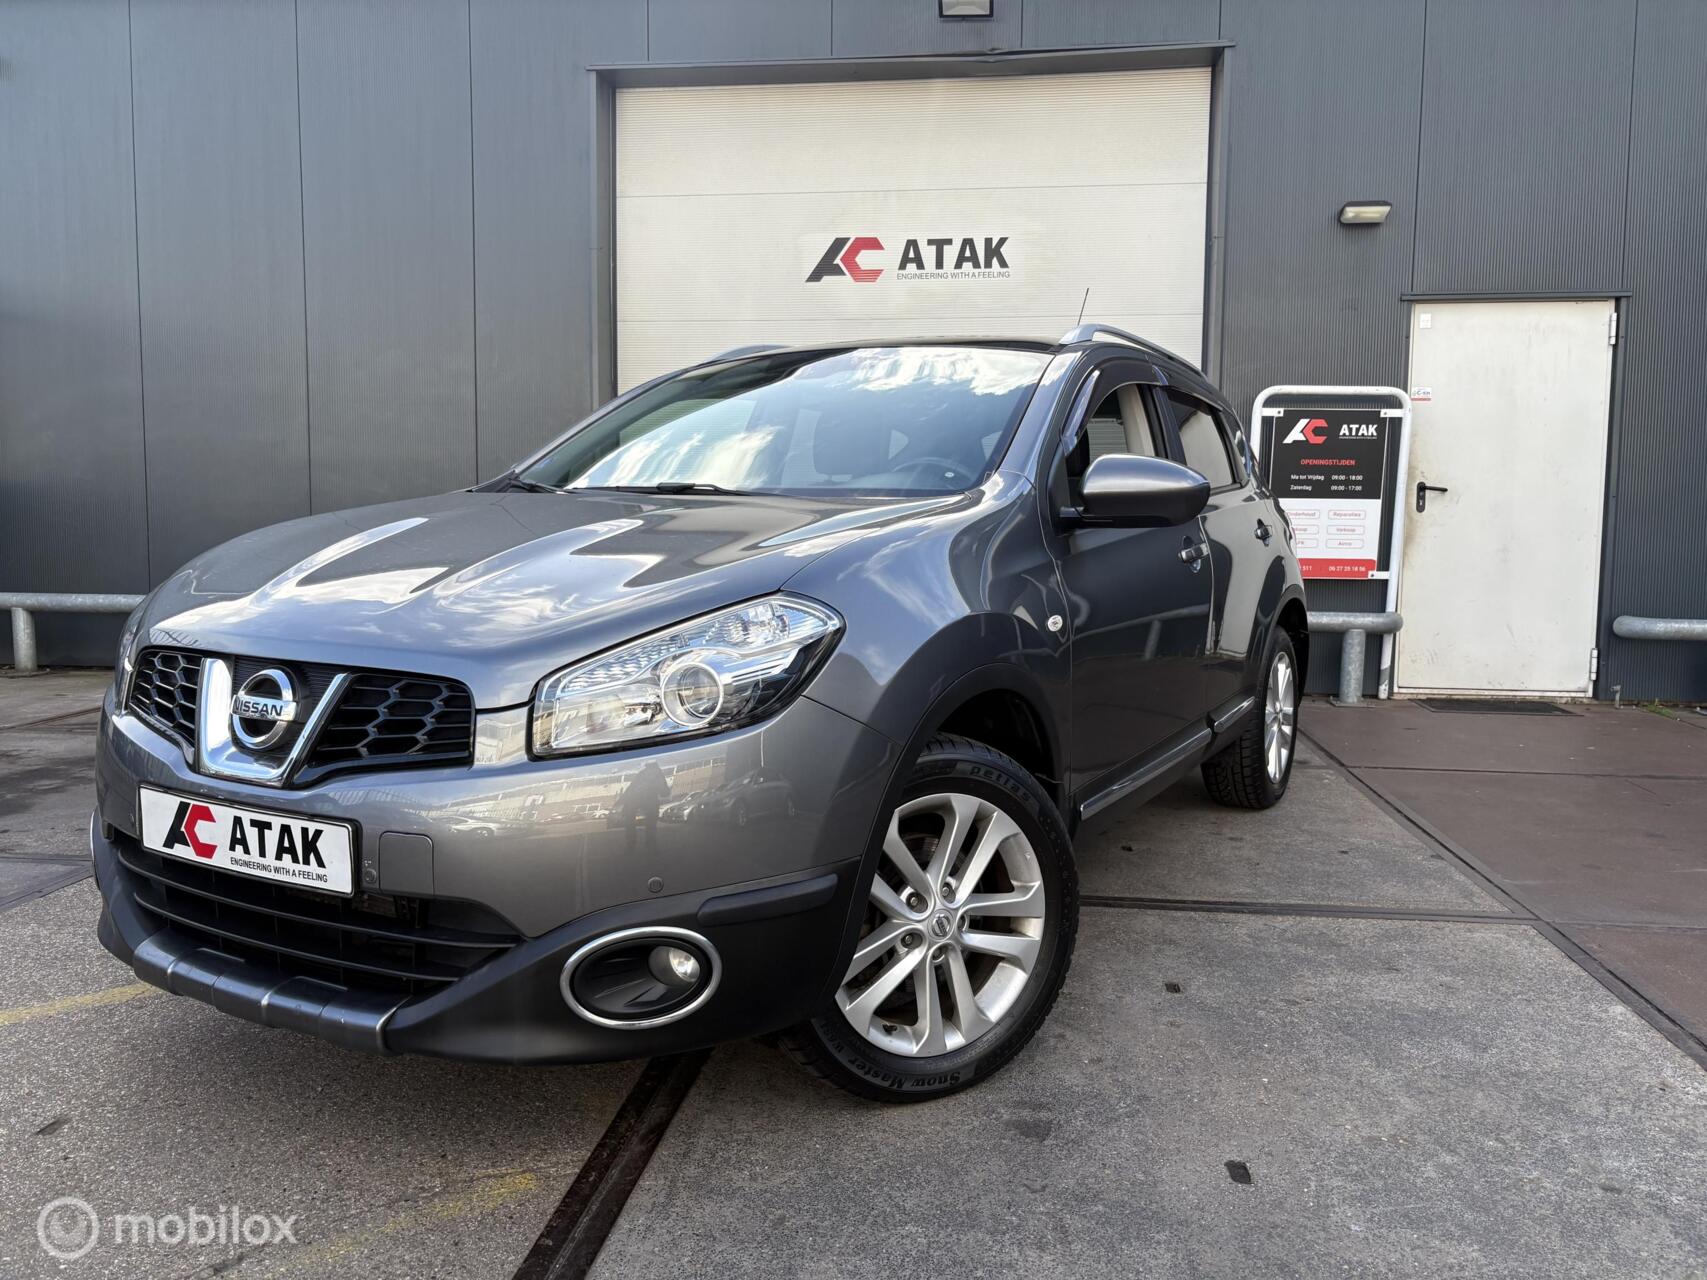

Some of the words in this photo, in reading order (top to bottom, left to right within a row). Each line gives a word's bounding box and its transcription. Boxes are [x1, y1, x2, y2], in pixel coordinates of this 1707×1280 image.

[897, 236, 1010, 271] ATAK
[896, 272, 949, 280] ENGINEERING
[950, 272, 970, 280] WITH
[977, 271, 1010, 279] FEELING
[1339, 424, 1378, 436] ATAK
[232, 695, 283, 717] NISSAN
[228, 815, 326, 869] ATAK
[230, 857, 272, 873] ENGINEERING
[272, 865, 290, 877] WITH
[291, 869, 297, 878] A
[298, 870, 328, 883] FEELING
[848, 1057, 906, 1089] Master
[910, 1071, 961, 1087] Snow
